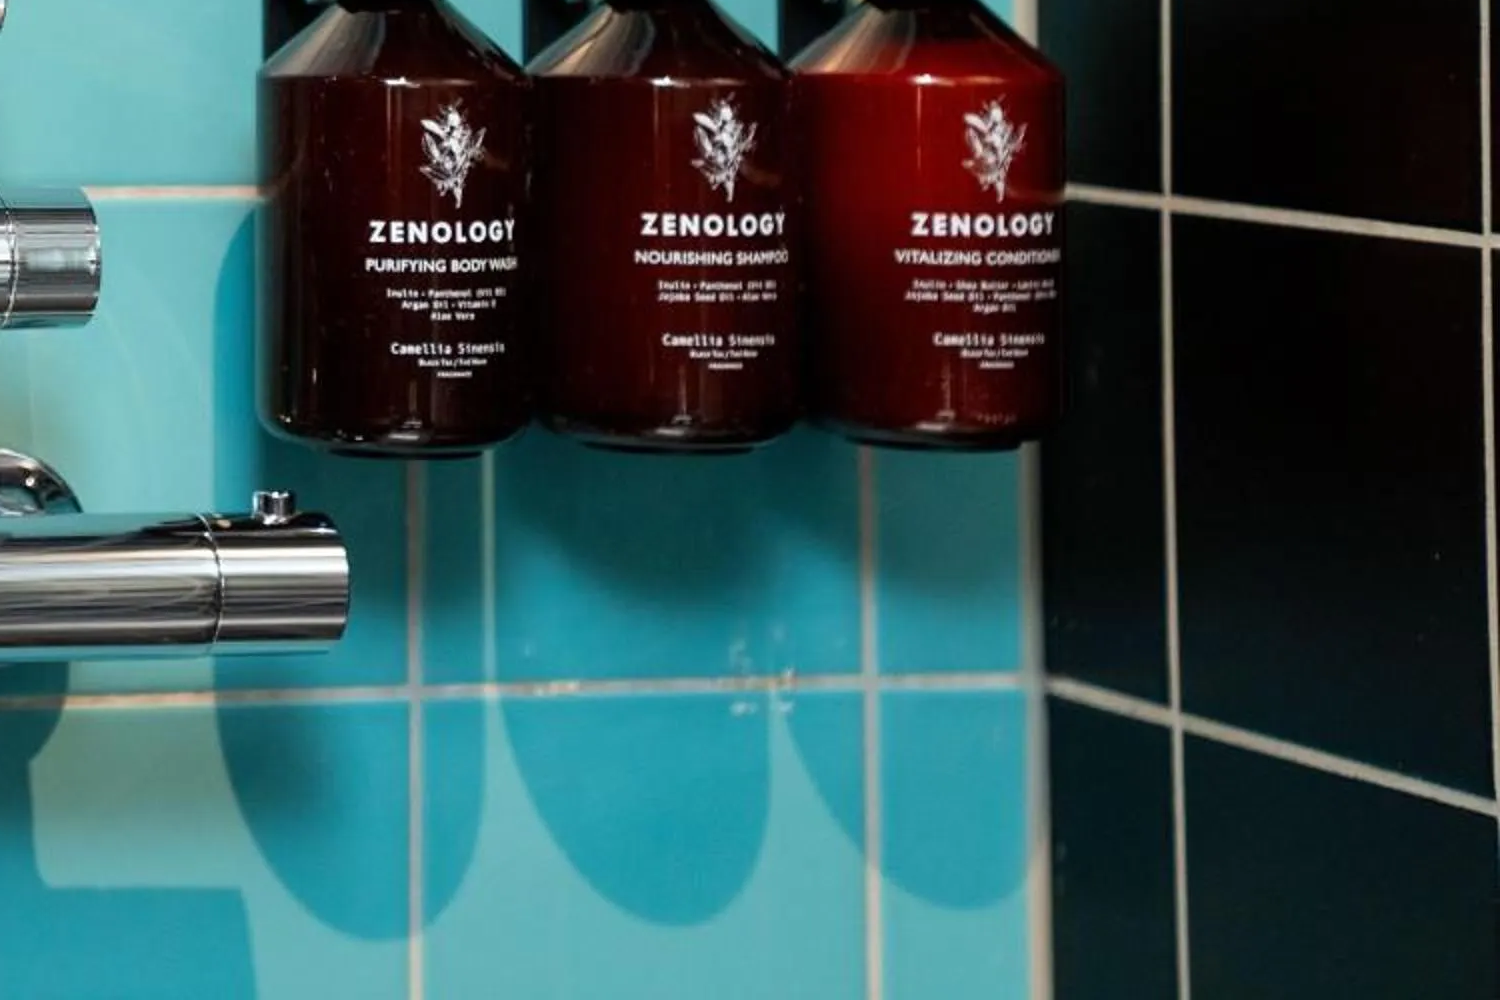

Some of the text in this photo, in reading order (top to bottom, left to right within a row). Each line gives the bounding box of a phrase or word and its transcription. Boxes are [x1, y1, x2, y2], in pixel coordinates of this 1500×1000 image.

[369, 220, 515, 243] ZENOLOGY
[640, 212, 785, 237] ZENOLOGY
[910, 212, 1055, 237] ZENOLOGY
[634, 249, 788, 265] NOURISHING SHAMPOO
[894, 249, 1061, 265] VITALIZING CONDITION
[365, 258, 446, 273] PURIFYING
[451, 259, 486, 273] BODY
[662, 332, 723, 347] Camellia
[390, 342, 452, 355] Camellia
